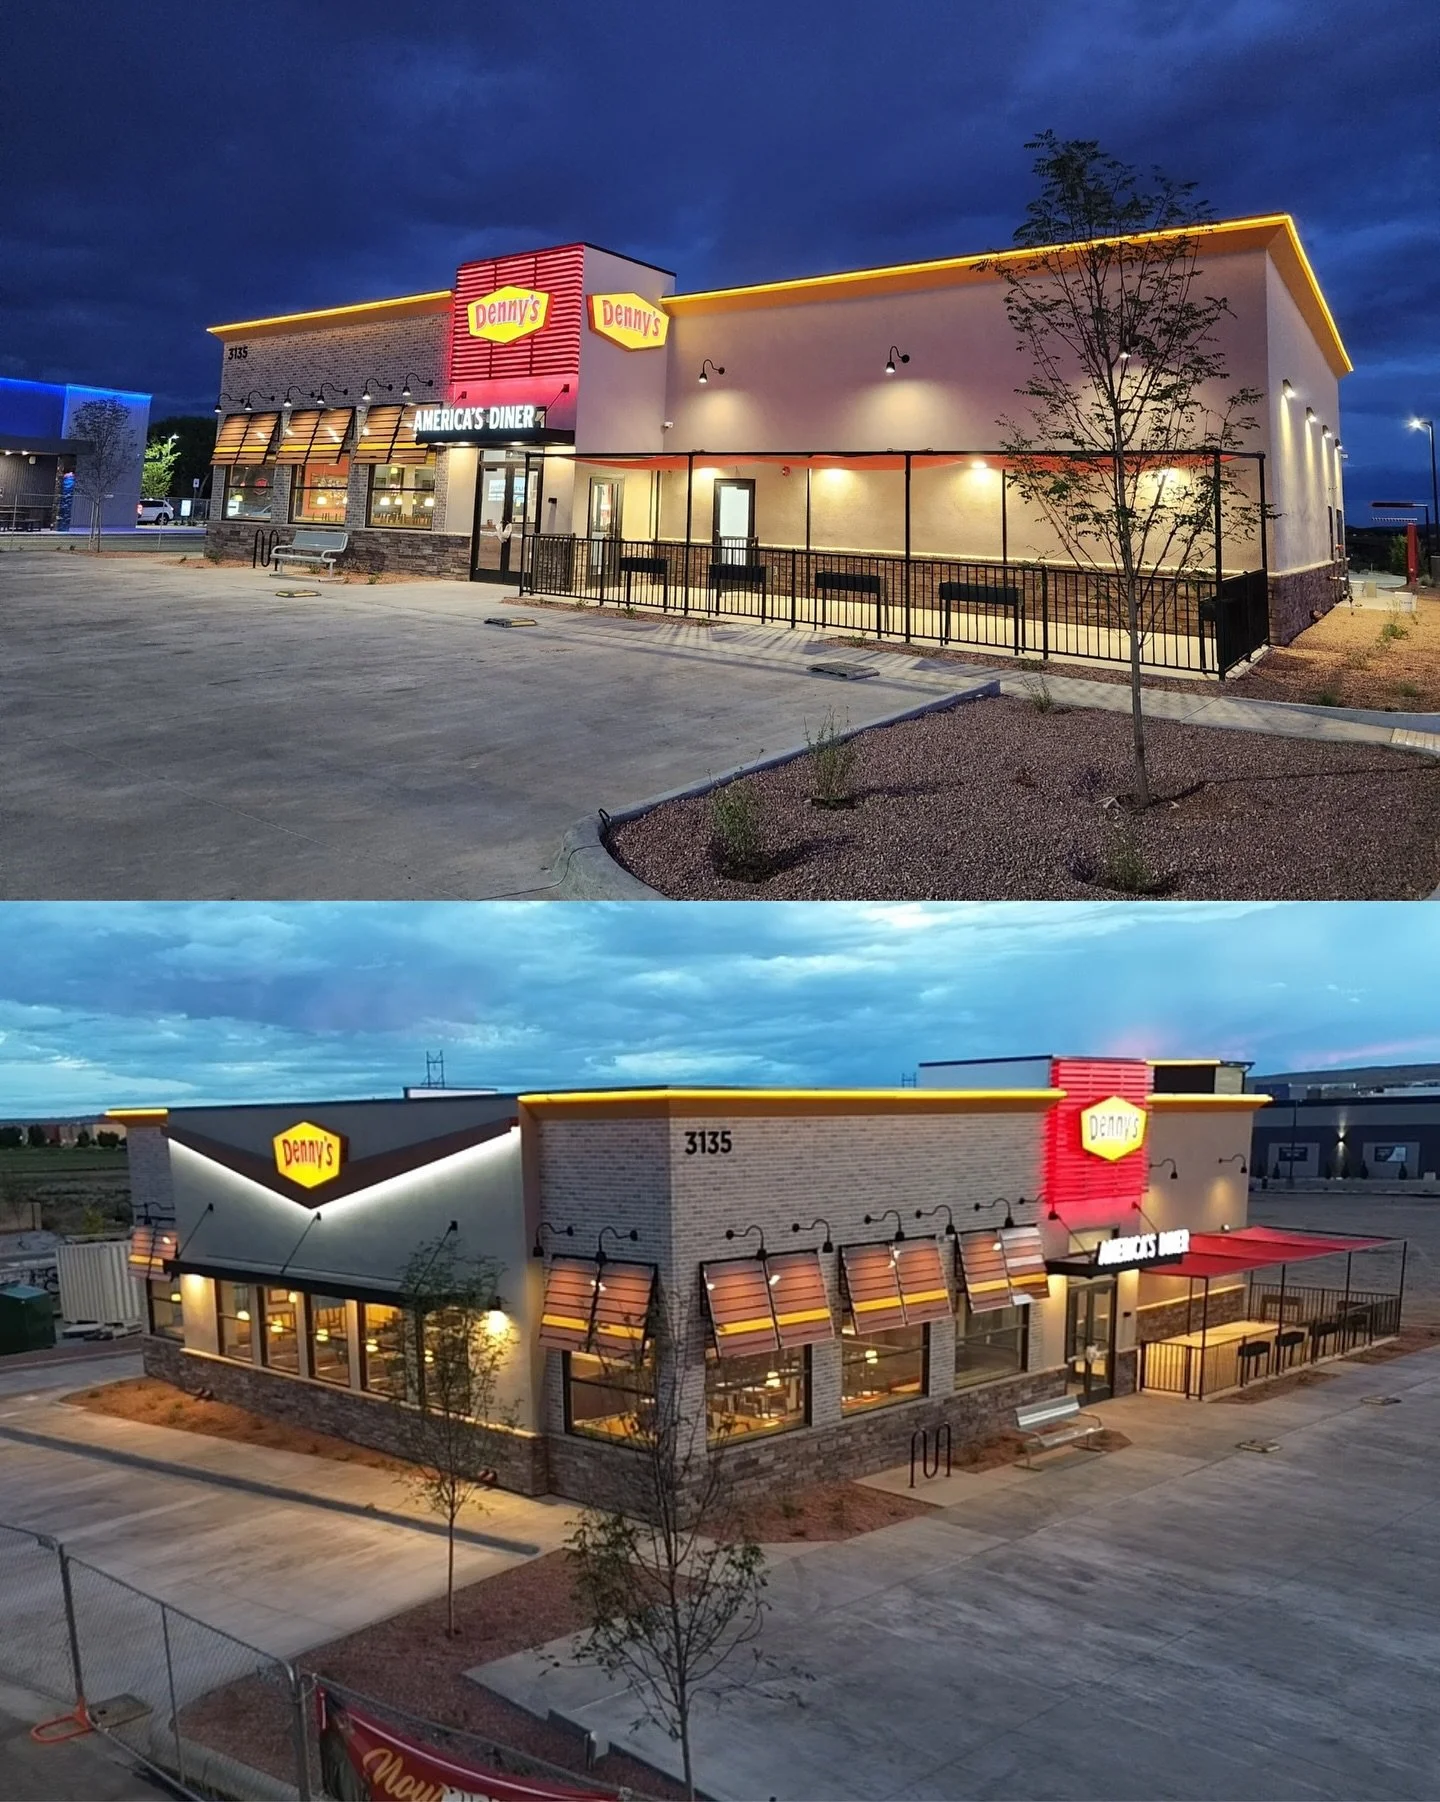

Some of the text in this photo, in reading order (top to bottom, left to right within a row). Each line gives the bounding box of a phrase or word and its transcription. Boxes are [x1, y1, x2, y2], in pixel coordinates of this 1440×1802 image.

[475, 294, 541, 330] Denny's
[602, 299, 662, 338] Denny's
[228, 345, 249, 360] 3135
[413, 405, 535, 431] AMERICA'S DINER
[1089, 1111, 1139, 1141] Denny's
[281, 1136, 333, 1170] Denny's
[684, 1130, 732, 1155] 3135
